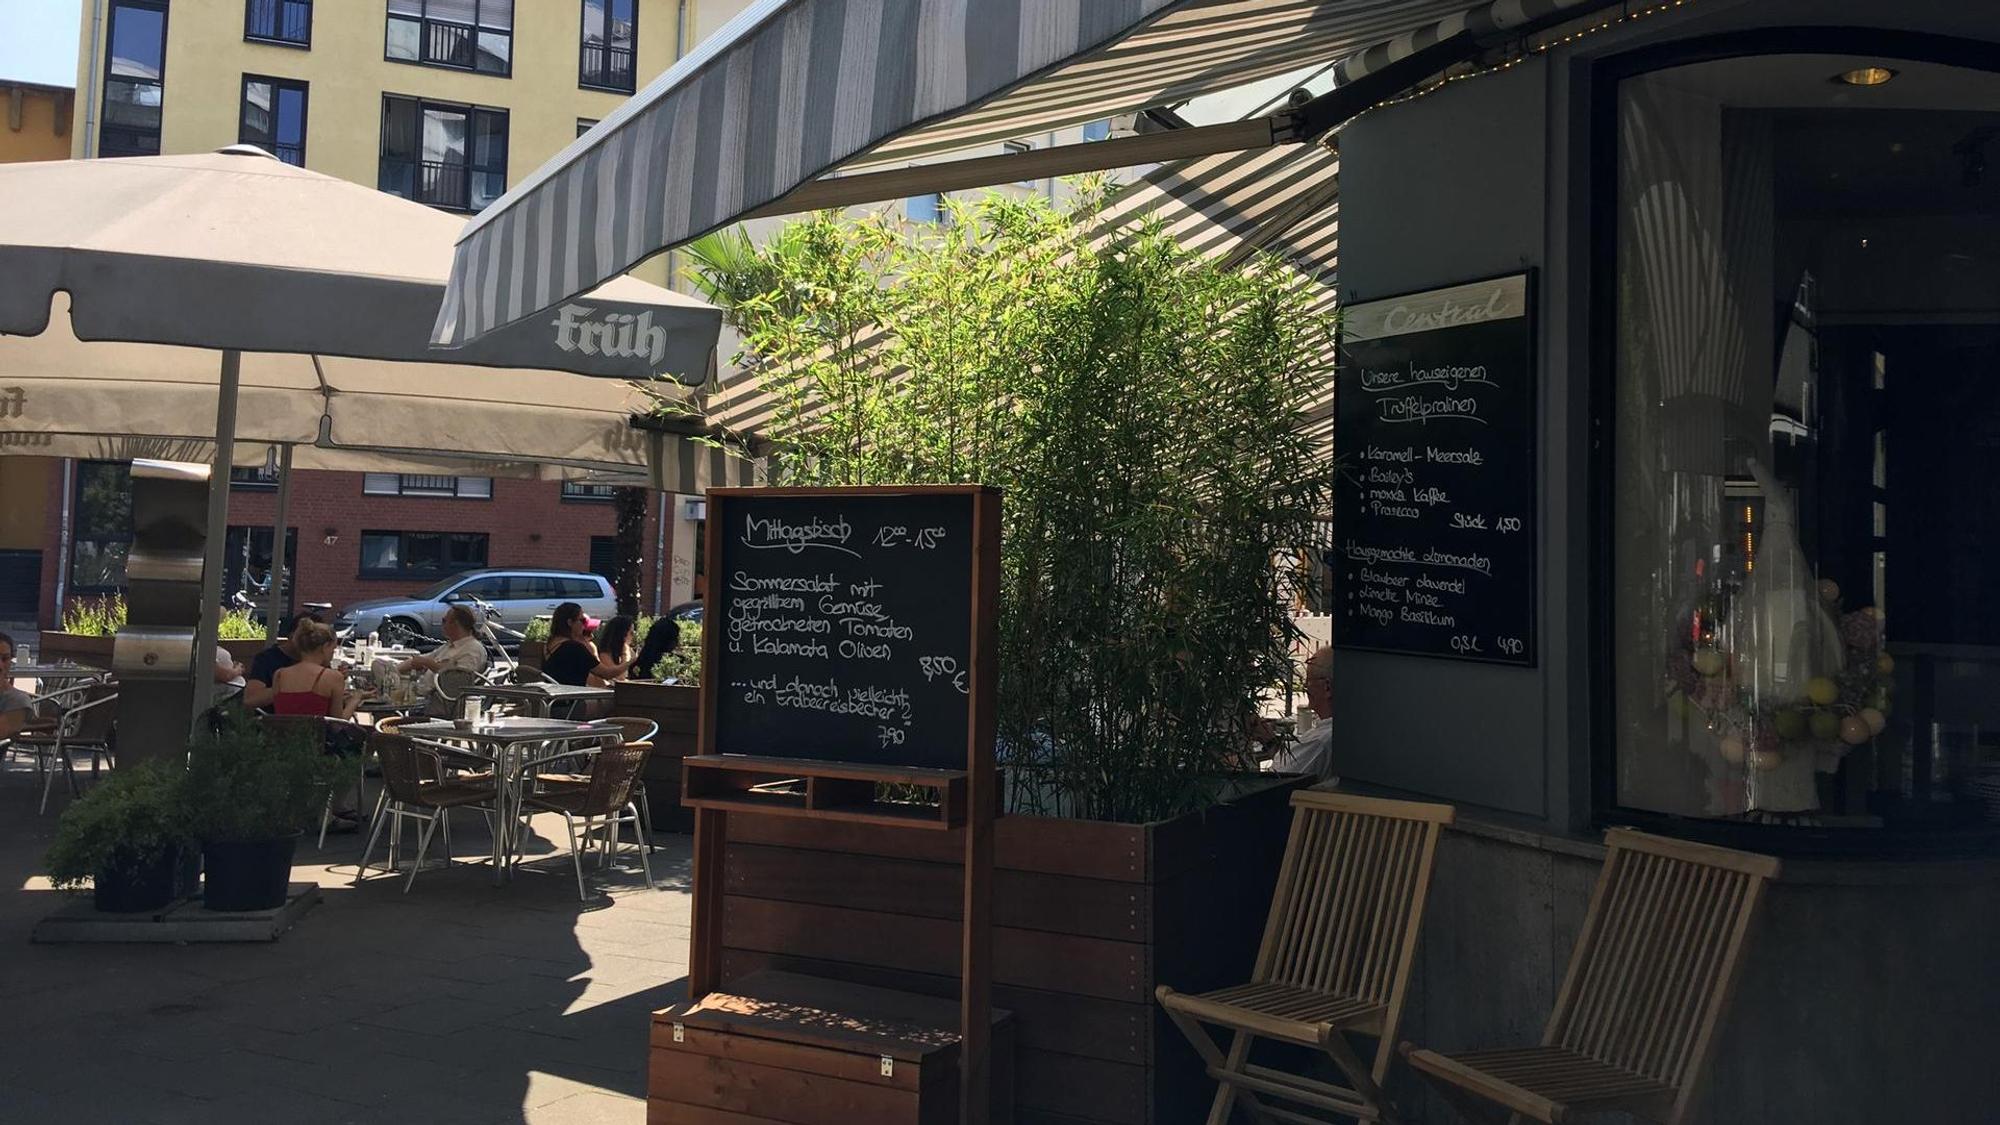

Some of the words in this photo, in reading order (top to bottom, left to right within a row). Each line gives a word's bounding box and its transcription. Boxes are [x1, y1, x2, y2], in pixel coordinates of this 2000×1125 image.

[1384, 288, 1508, 333] Central
[551, 303, 667, 367] Früh
[1361, 366, 1404, 387] Unsere
[1409, 361, 1488, 391] hauseigenen
[1412, 487, 1452, 507] Kaffee
[744, 512, 852, 553] Mittagstisch
[1449, 511, 1489, 530] Stück
[1495, 516, 1522, 535] 1,50
[323, 536, 339, 545] 47
[1345, 537, 1417, 566] Hausgemachte
[1421, 546, 1492, 575] Limonaden
[729, 571, 841, 592] Sommersalat
[850, 577, 883, 598] mit
[728, 593, 805, 621] gegrilltem
[1405, 589, 1444, 608] Minze
[728, 615, 831, 641] getrockneten
[839, 617, 914, 641] Tomaten
[1360, 603, 1395, 627] Mango
[1400, 606, 1456, 630] Basilikum
[753, 633, 829, 660] Kalamata
[838, 639, 892, 661] Oliven
[1496, 635, 1524, 656] 4,90
[919, 656, 957, 682] 8,50
[952, 671, 970, 694] €
[744, 690, 766, 705] ein
[785, 675, 839, 699] danach
[848, 685, 910, 707] vielleicht
[878, 724, 905, 750] 7,90
